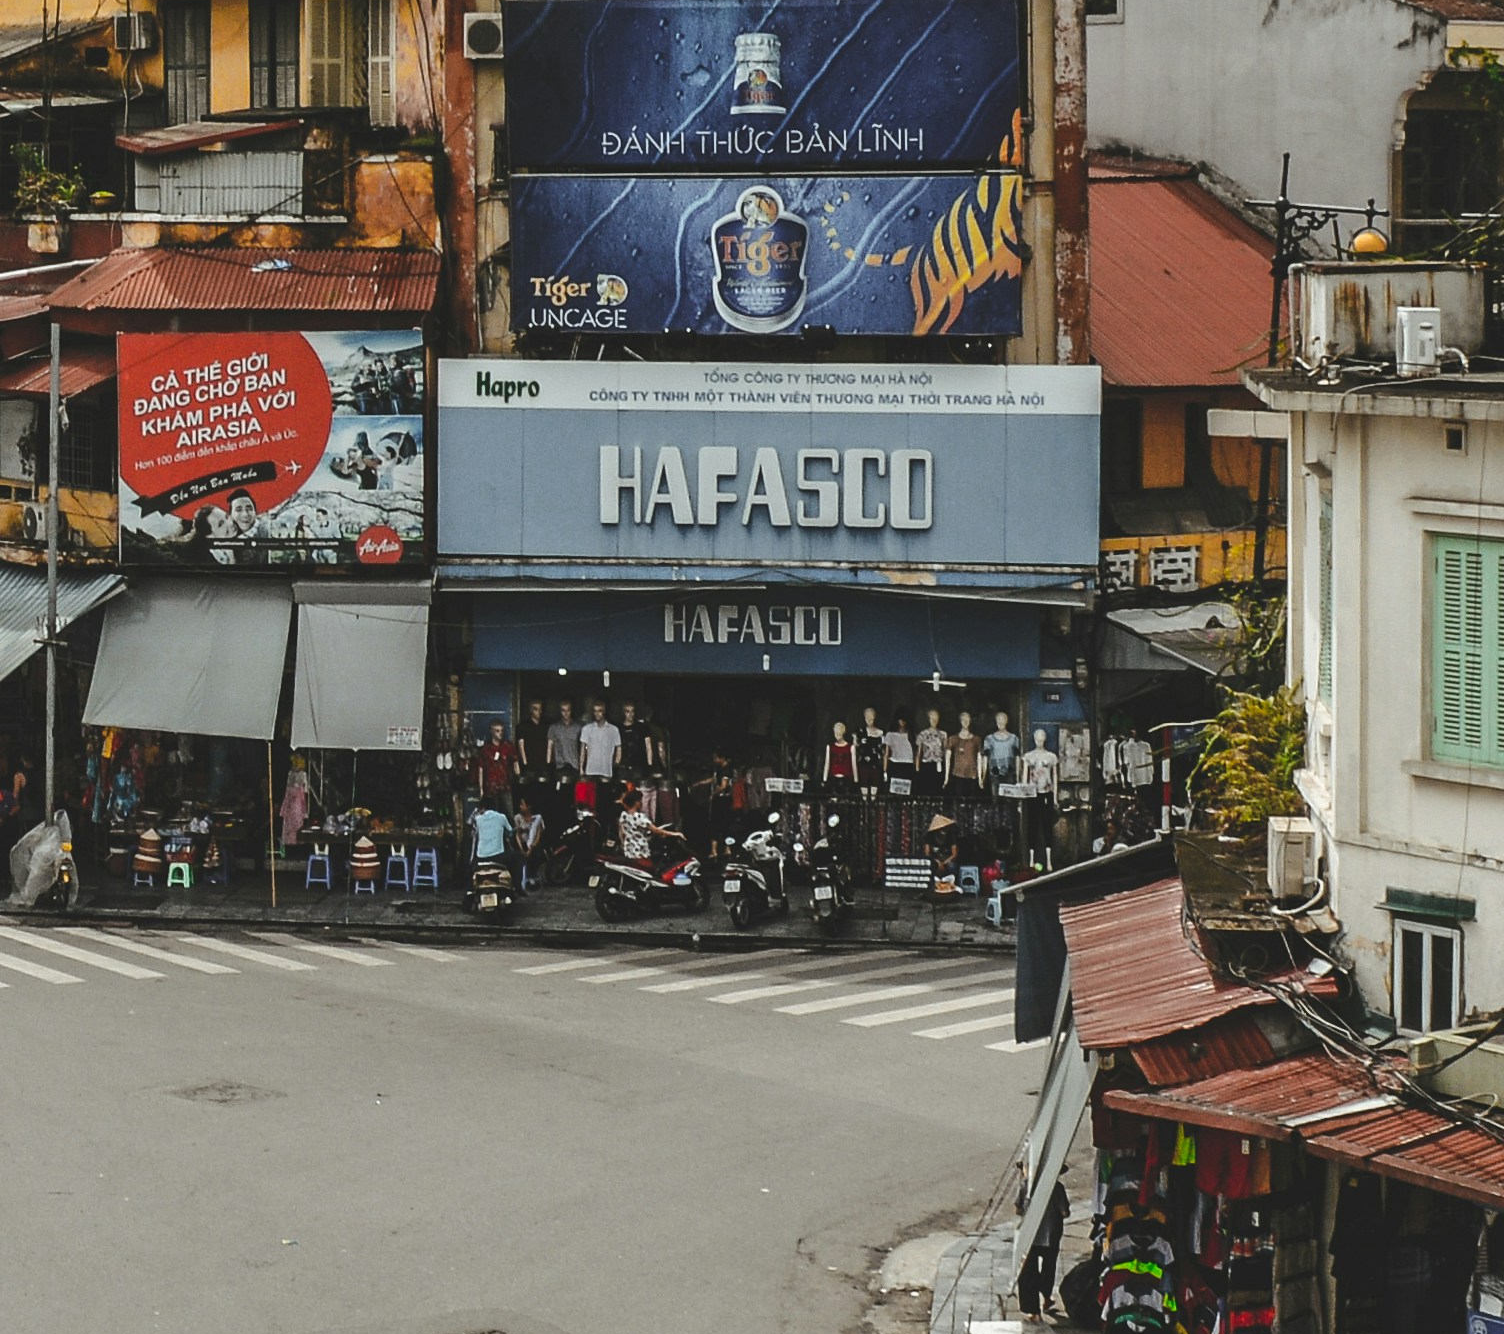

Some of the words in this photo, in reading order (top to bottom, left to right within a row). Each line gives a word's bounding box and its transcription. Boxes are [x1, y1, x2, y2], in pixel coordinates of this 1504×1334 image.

[601, 128, 686, 157] ĐÁNH
[696, 124, 775, 157] THỨC
[785, 121, 847, 155] BẢN
[856, 124, 924, 154] LĨNH
[718, 231, 802, 277] Tiger
[530, 275, 591, 305] Tiger
[529, 308, 628, 330] UNCAGE
[151, 370, 180, 393] CẢ
[183, 360, 222, 386] THẾ
[226, 352, 269, 377] GIỚI
[475, 371, 541, 400] Hapro
[703, 366, 740, 385] TỔNG
[743, 369, 784, 385] CÔNG
[786, 373, 802, 385] TY
[804, 371, 856, 386] THƯƠNG
[860, 373, 885, 387] MẠI
[887, 369, 906, 386] HÀ
[908, 370, 933, 387] NỘI
[133, 390, 191, 416] ĐANG
[195, 377, 241, 403] CHỜ
[244, 368, 287, 393] BẠN
[589, 387, 629, 403] CÔNG
[631, 391, 649, 402] TY
[652, 391, 691, 403] TNHH
[694, 389, 725, 406] MỘT
[728, 388, 776, 404] THÀNH
[779, 389, 811, 405] VIÊN
[816, 392, 874, 406] THƯƠNG
[878, 393, 904, 408] MẠI
[908, 390, 941, 406] THỜI
[945, 394, 993, 407] TRANG
[995, 390, 1016, 407] HÀ
[1019, 391, 1046, 408] NỘI
[141, 410, 204, 437] KHÁM
[209, 397, 253, 423] PHÁ
[257, 389, 296, 413] VỚI
[176, 417, 262, 449] AIRASIA
[598, 444, 934, 531] HAFASCO
[663, 603, 843, 647] HAFASCO
